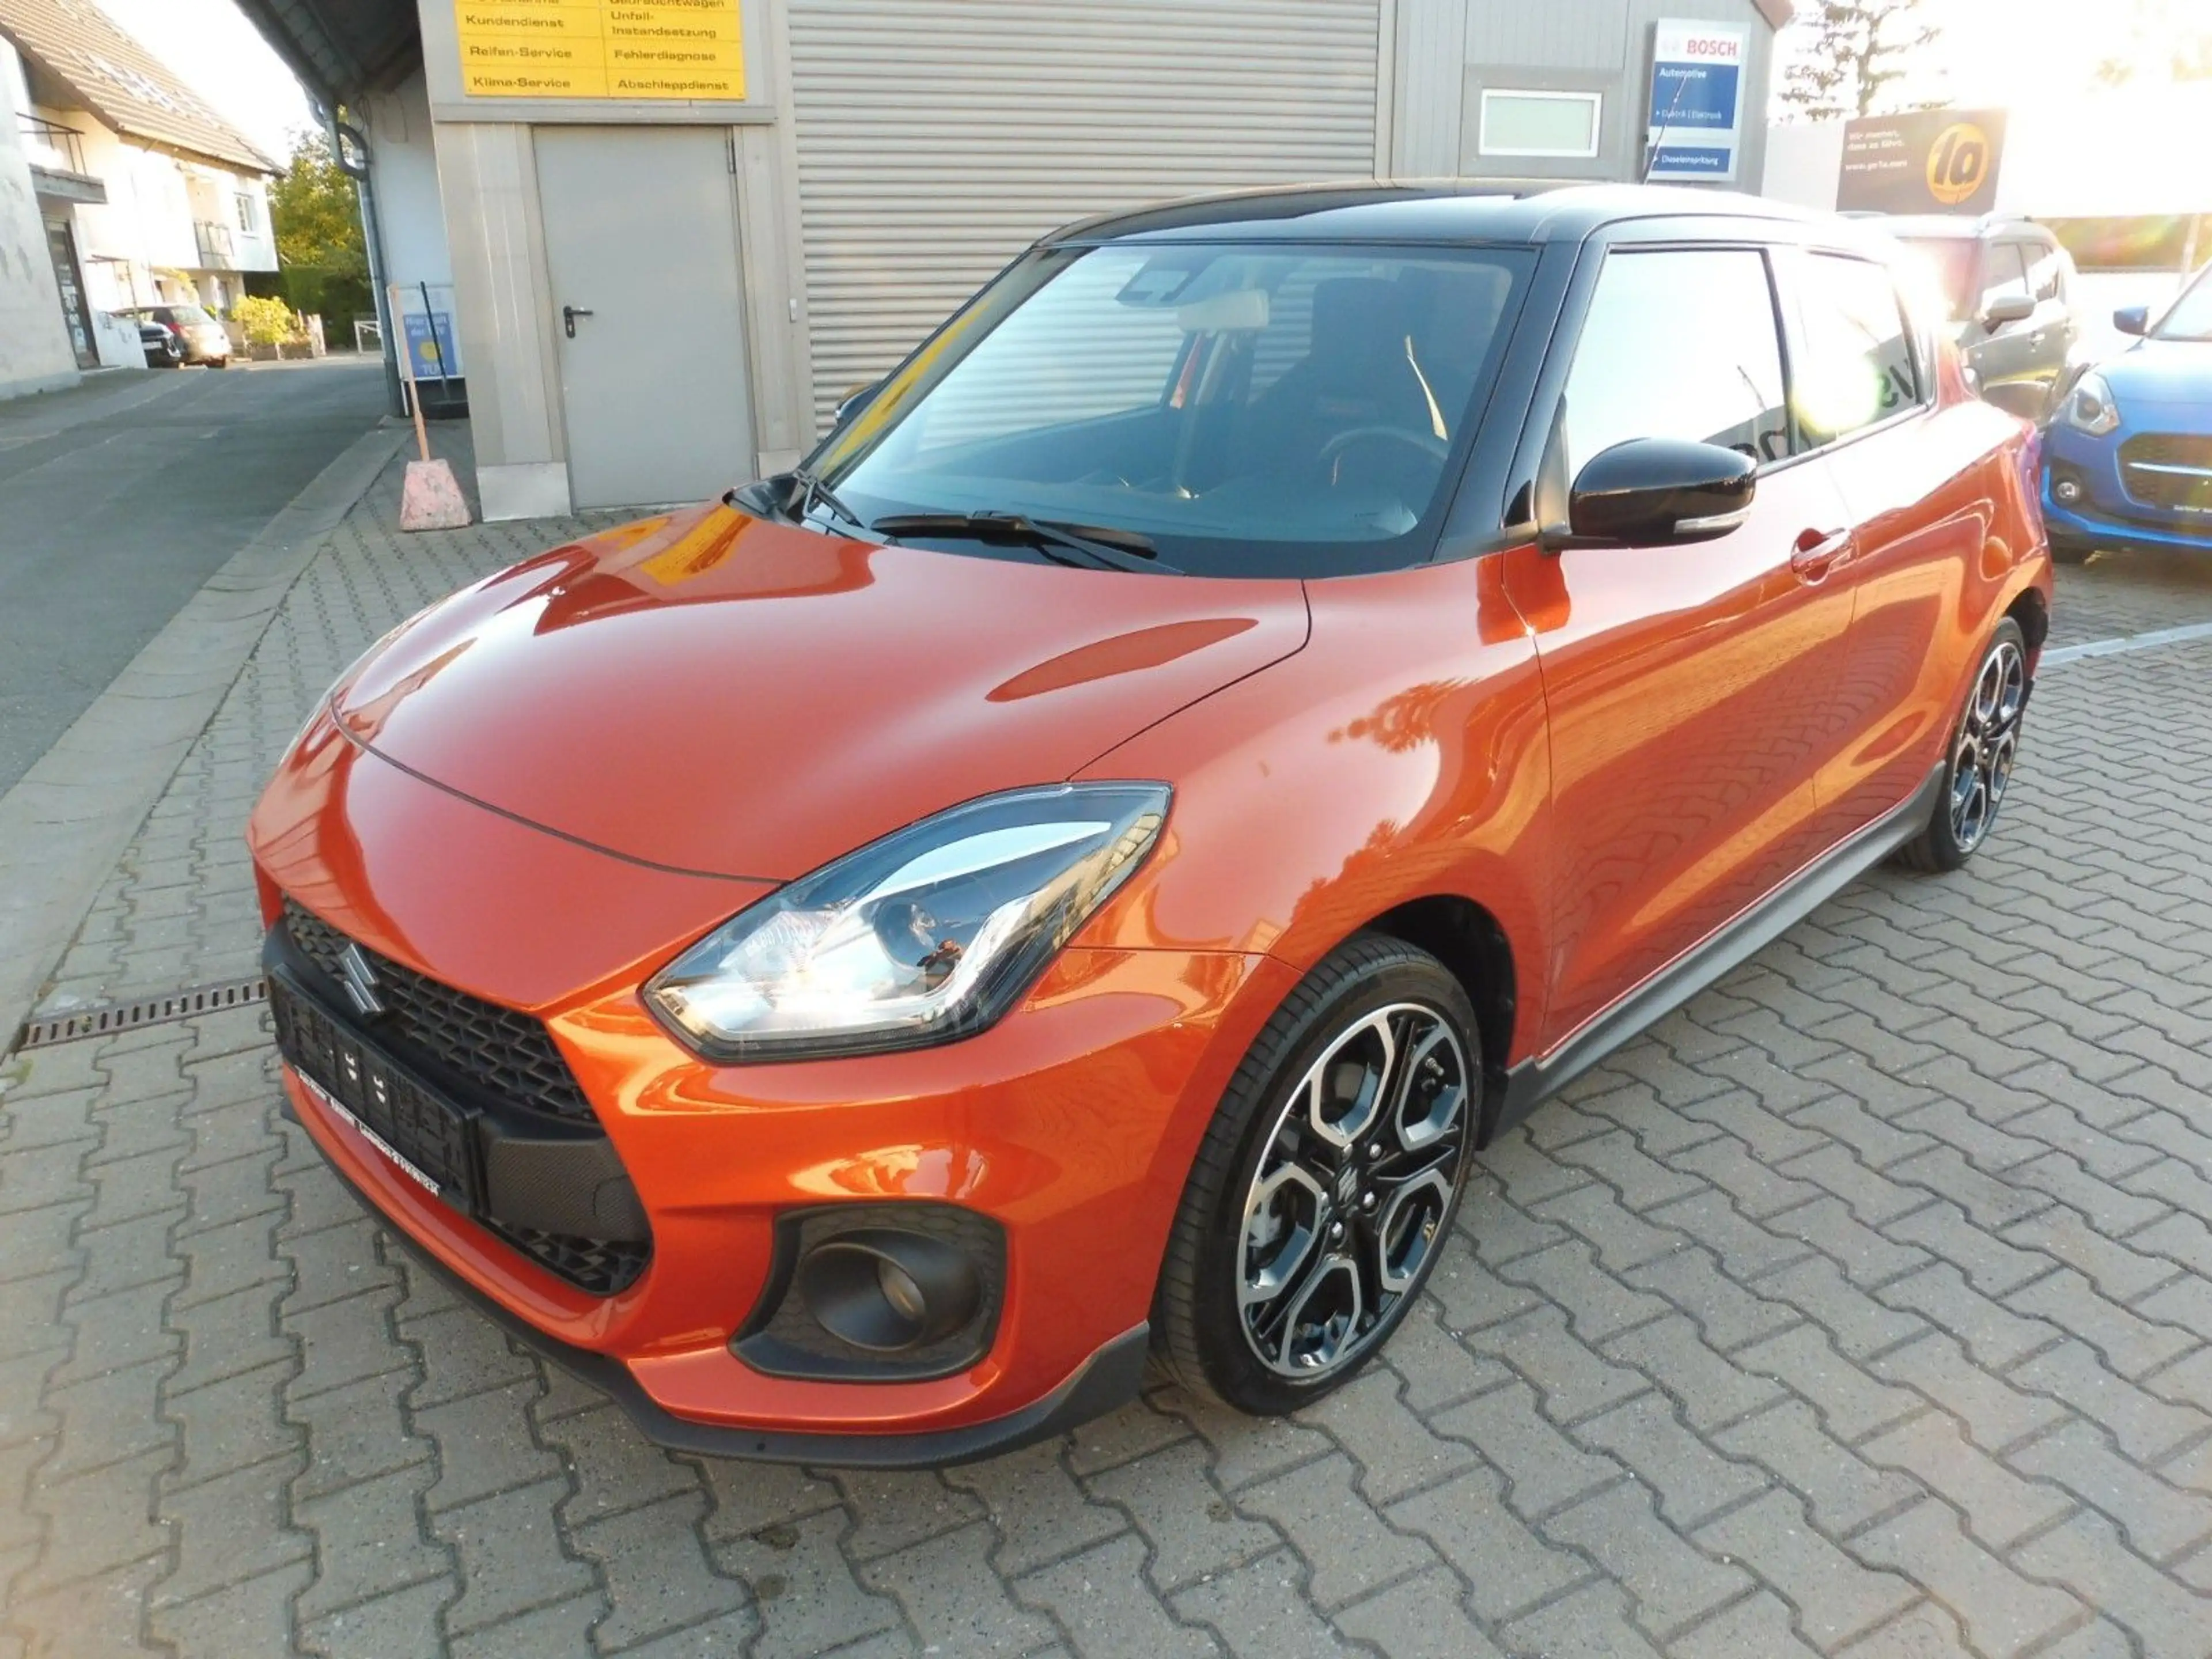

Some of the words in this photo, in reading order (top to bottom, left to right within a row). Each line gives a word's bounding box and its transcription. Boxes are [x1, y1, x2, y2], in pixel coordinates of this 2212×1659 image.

[465, 14, 565, 28] Kundendienst
[611, 11, 654, 21] Unfall-
[612, 26, 717, 39] Instandsetzung
[469, 45, 573, 59] Reifen-Service
[1687, 39, 1737, 56] BOSCH
[614, 50, 717, 63] Fehlerdiagnose
[1659, 67, 1707, 78] Automotive
[473, 76, 571, 89] Klima-Service
[618, 79, 730, 92] Abschleppdienst
